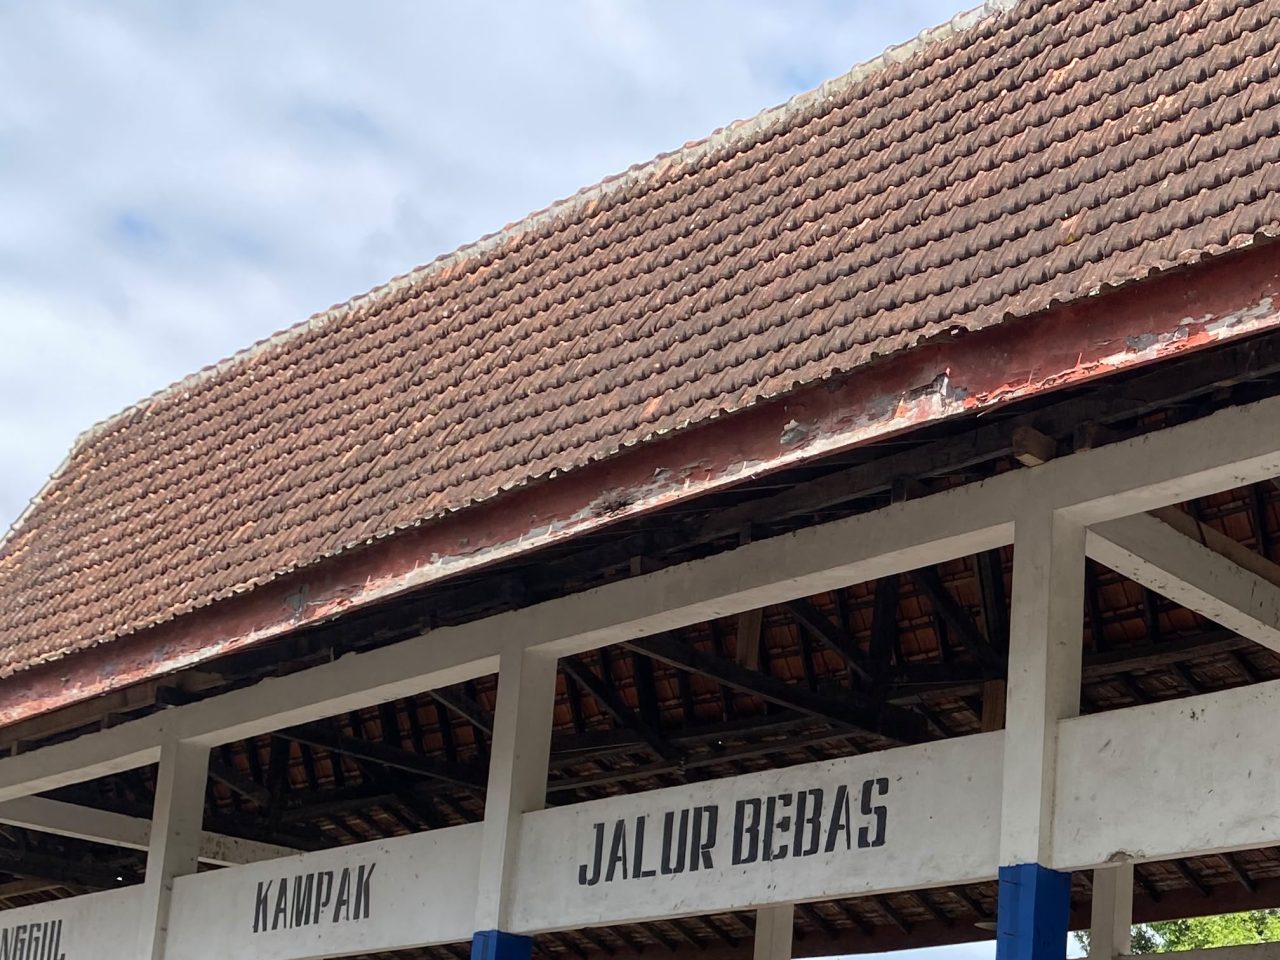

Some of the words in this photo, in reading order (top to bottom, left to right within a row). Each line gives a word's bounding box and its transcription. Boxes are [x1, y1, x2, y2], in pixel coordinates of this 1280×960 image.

[578, 804, 719, 886] JALUR
[731, 777, 890, 866] BEBAS
[253, 862, 376, 933] KAMPAK
